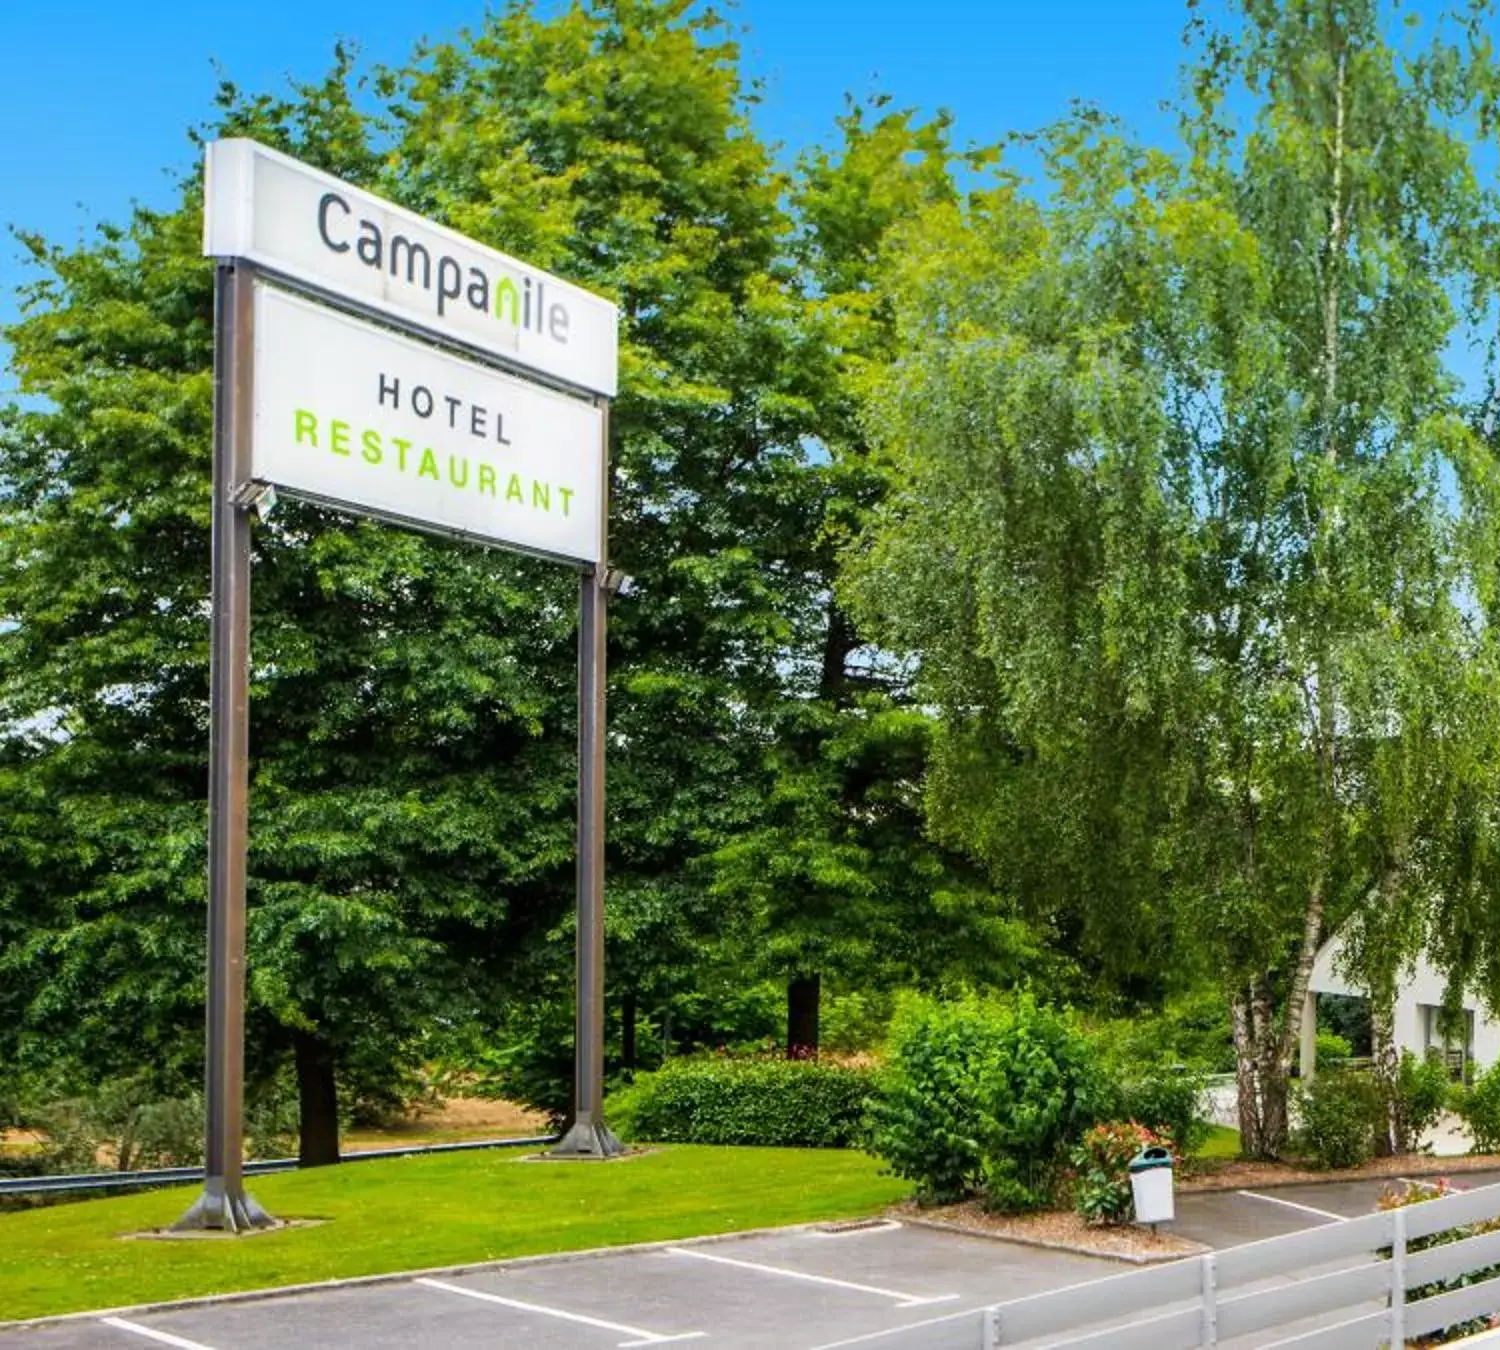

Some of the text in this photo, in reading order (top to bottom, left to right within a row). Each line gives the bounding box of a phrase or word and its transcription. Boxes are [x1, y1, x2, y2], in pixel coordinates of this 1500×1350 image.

[317, 193, 570, 344] Campanile
[293, 408, 575, 517] RESTAURANT
[378, 373, 512, 446] HOTEL
